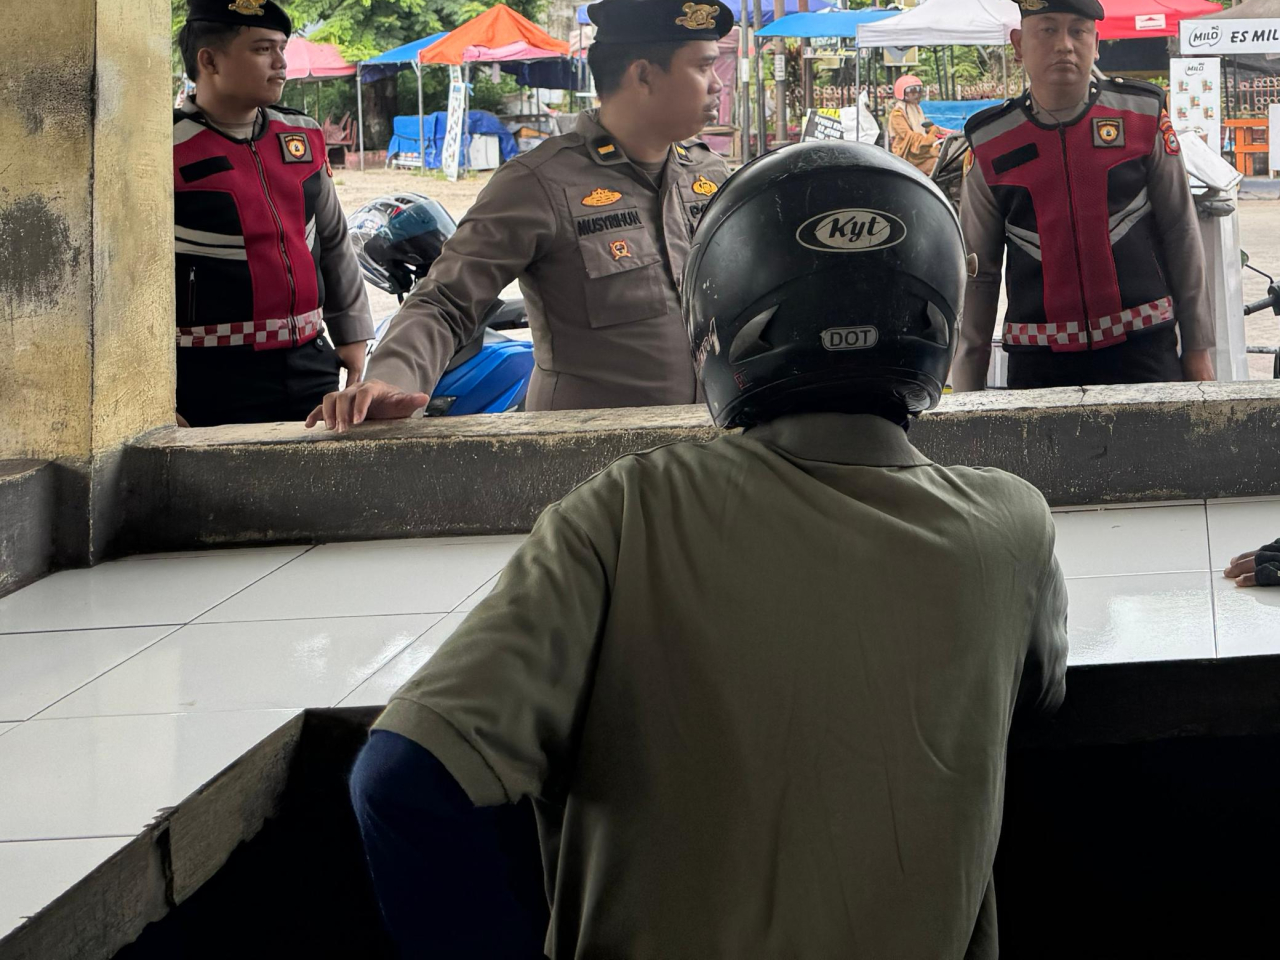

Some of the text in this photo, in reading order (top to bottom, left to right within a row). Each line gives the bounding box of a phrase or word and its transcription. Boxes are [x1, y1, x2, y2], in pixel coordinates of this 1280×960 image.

[1193, 31, 1219, 42] MILO
[1230, 30, 1249, 43] ES
[577, 210, 642, 237] MUSYRIHUN
[829, 329, 871, 348] DOT
